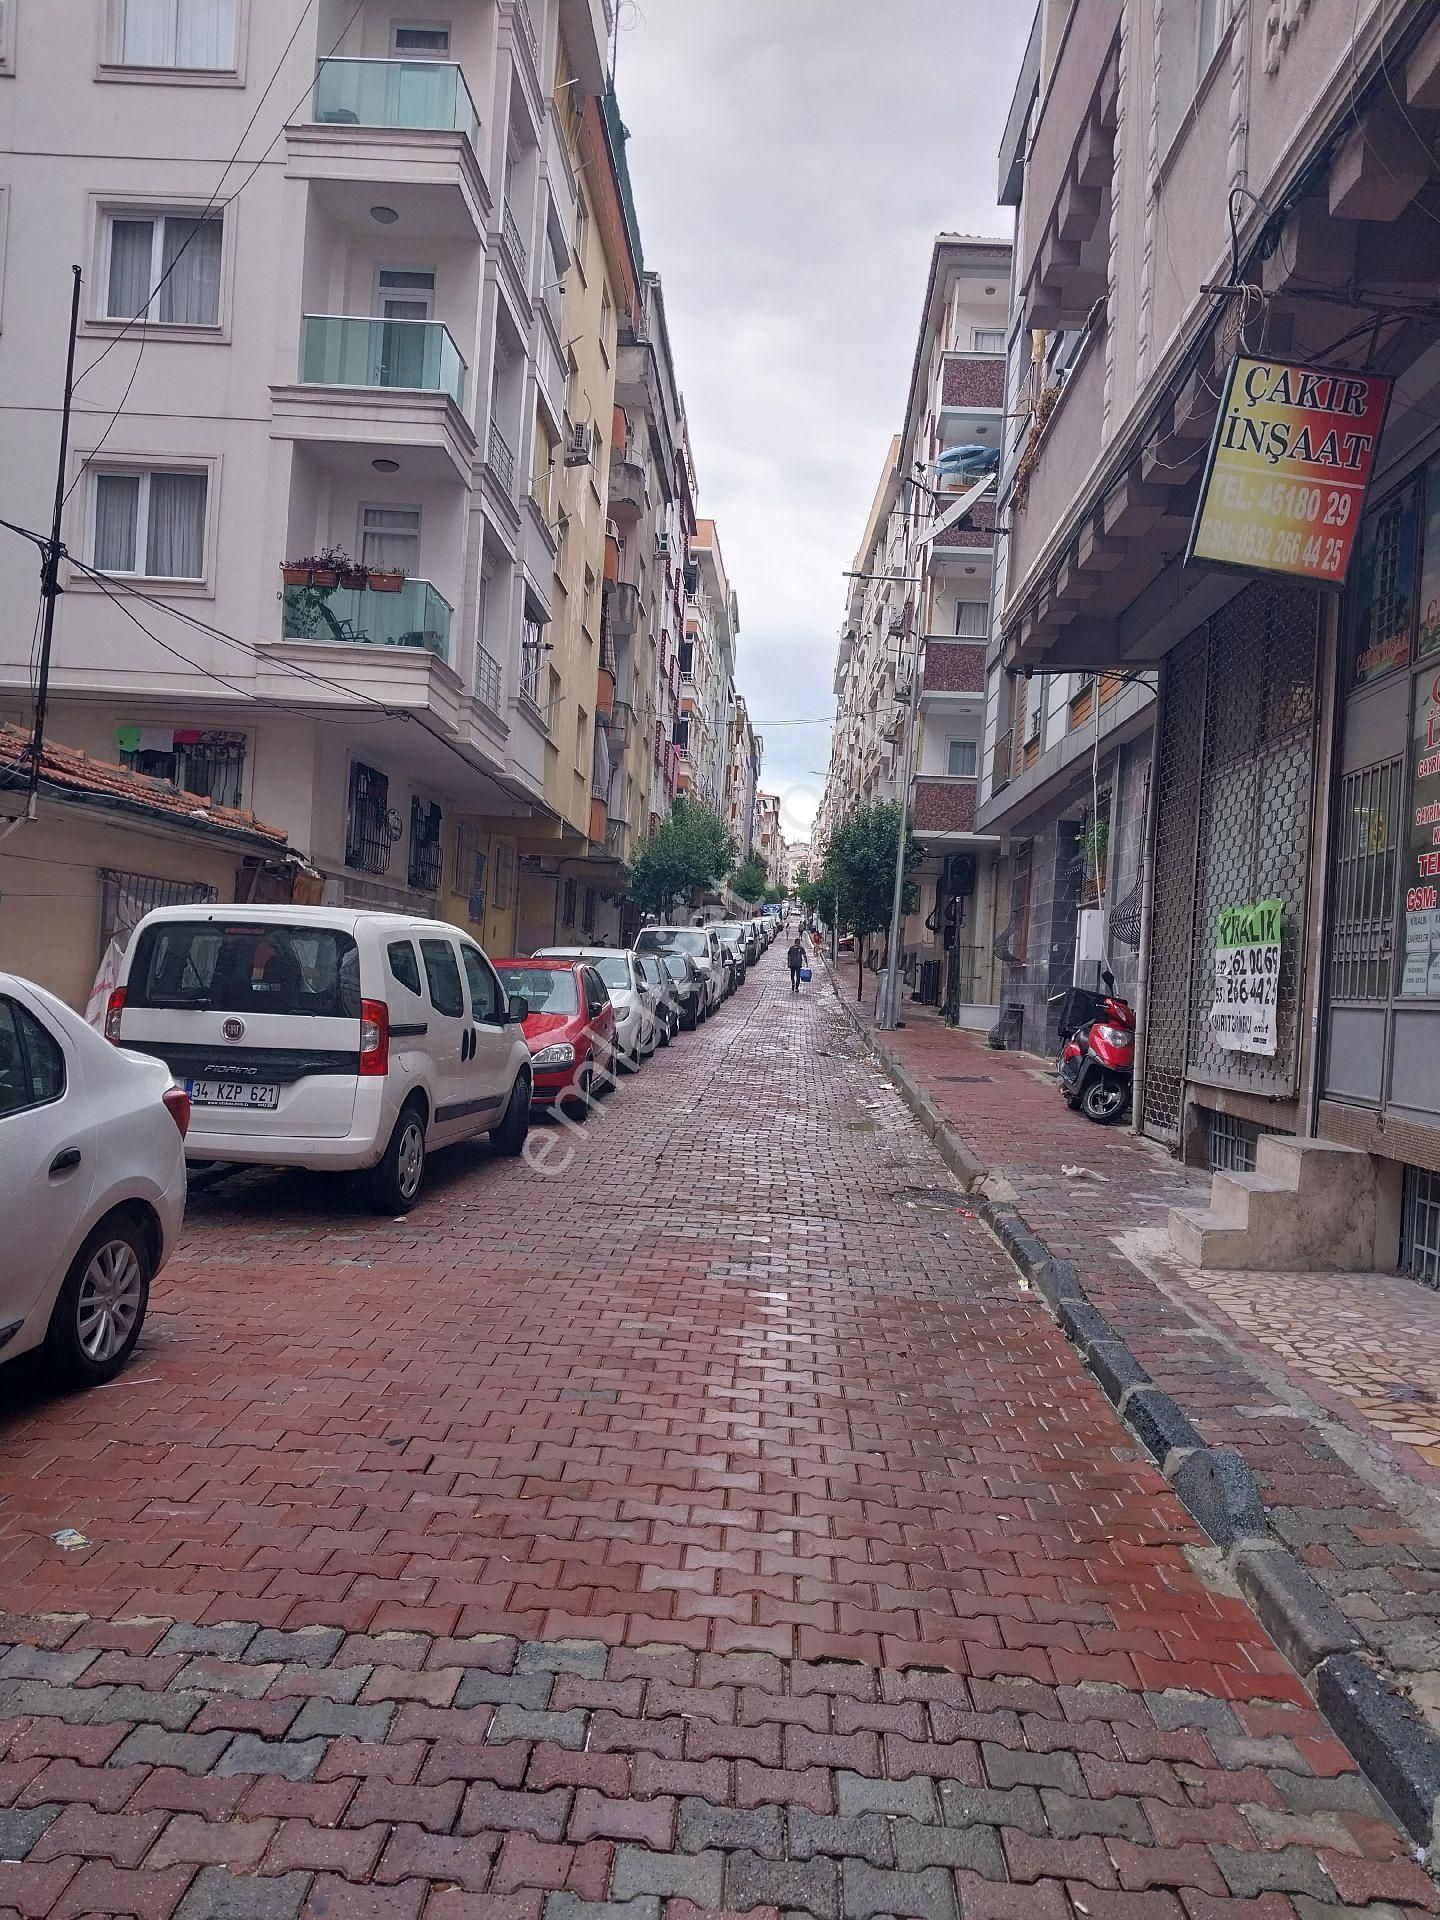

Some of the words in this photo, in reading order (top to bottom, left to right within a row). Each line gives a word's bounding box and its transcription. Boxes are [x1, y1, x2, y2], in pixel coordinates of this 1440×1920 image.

[1244, 366, 1369, 417] ÇAKIR
[1221, 407, 1372, 471] İNŞAAT
[1324, 491, 1351, 527] 29
[1276, 529, 1301, 565] 266
[1303, 533, 1322, 567] 44
[1323, 537, 1343, 572] 25
[1406, 886, 1437, 911] GSM:
[192, 1083, 209, 1098] 34
[217, 1084, 242, 1100] KZP
[250, 1086, 274, 1102] 621
